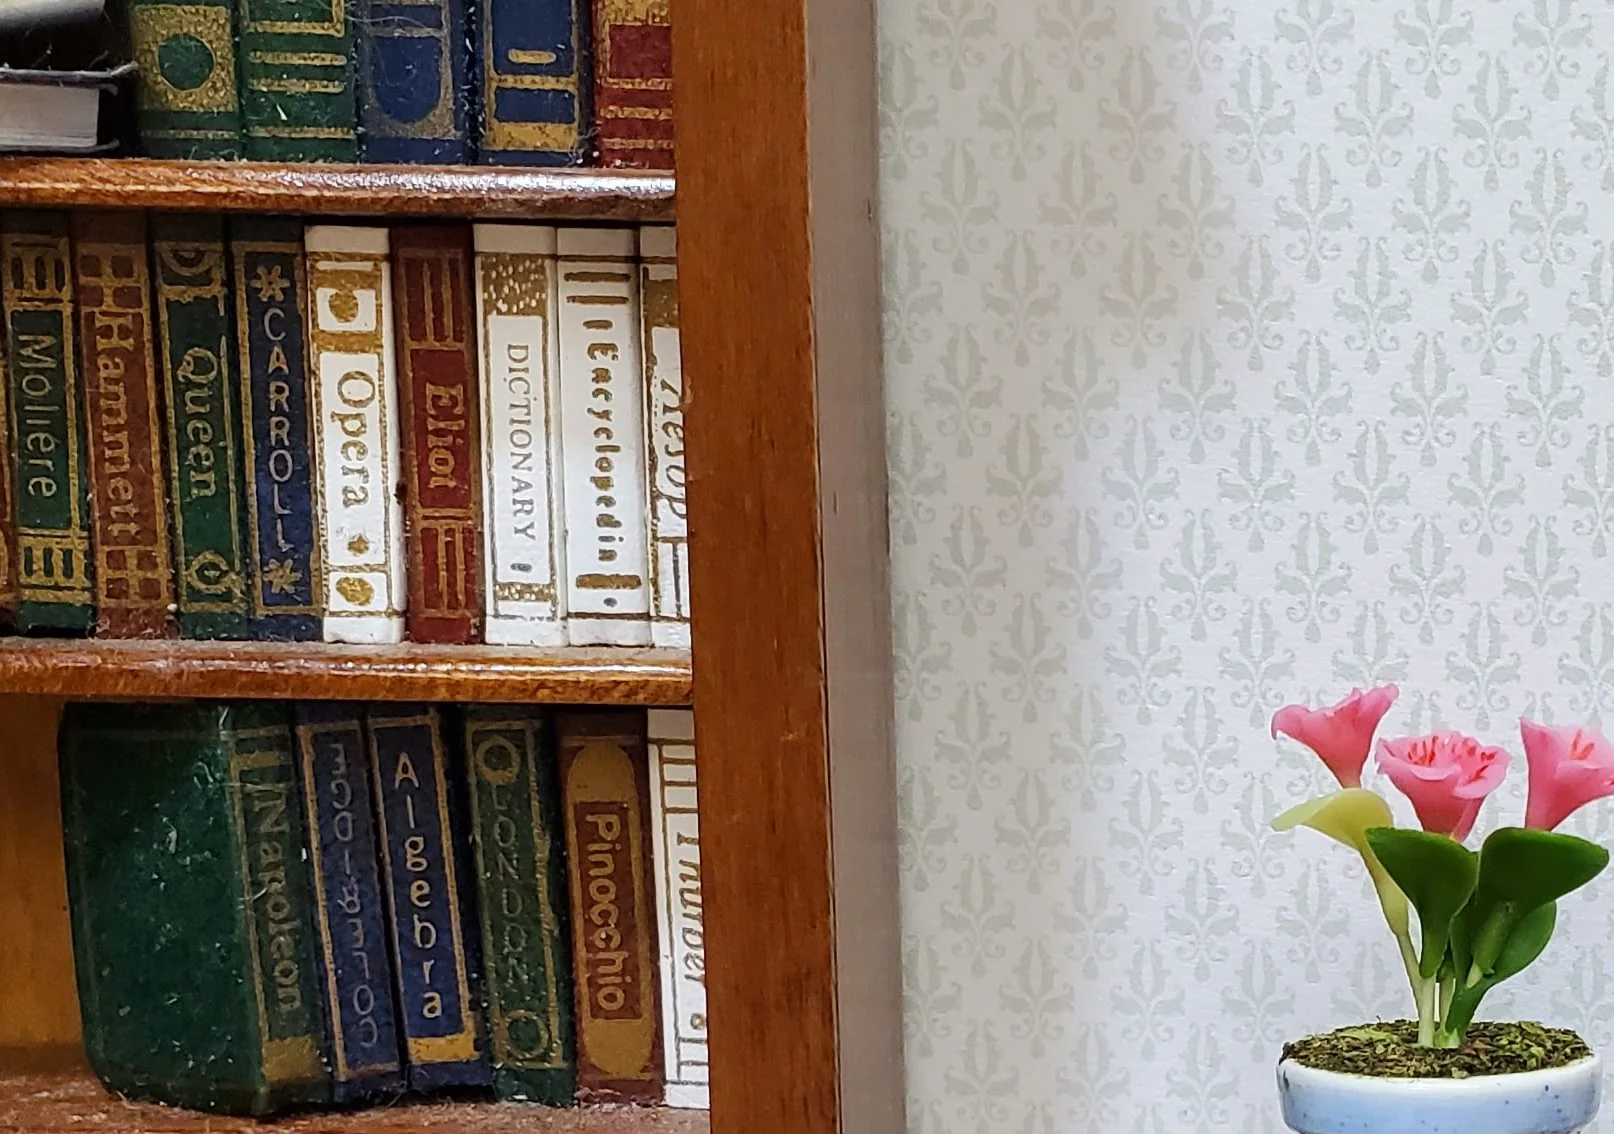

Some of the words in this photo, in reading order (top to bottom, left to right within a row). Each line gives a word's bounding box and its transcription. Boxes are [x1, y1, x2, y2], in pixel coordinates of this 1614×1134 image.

[176, 347, 218, 500] Queen
[264, 308, 294, 552] CARROLL
[330, 370, 376, 508] Opera
[506, 343, 537, 541] DICTIONARY
[395, 751, 443, 1019] Algebra
[585, 812, 633, 1012] Pinocchio
